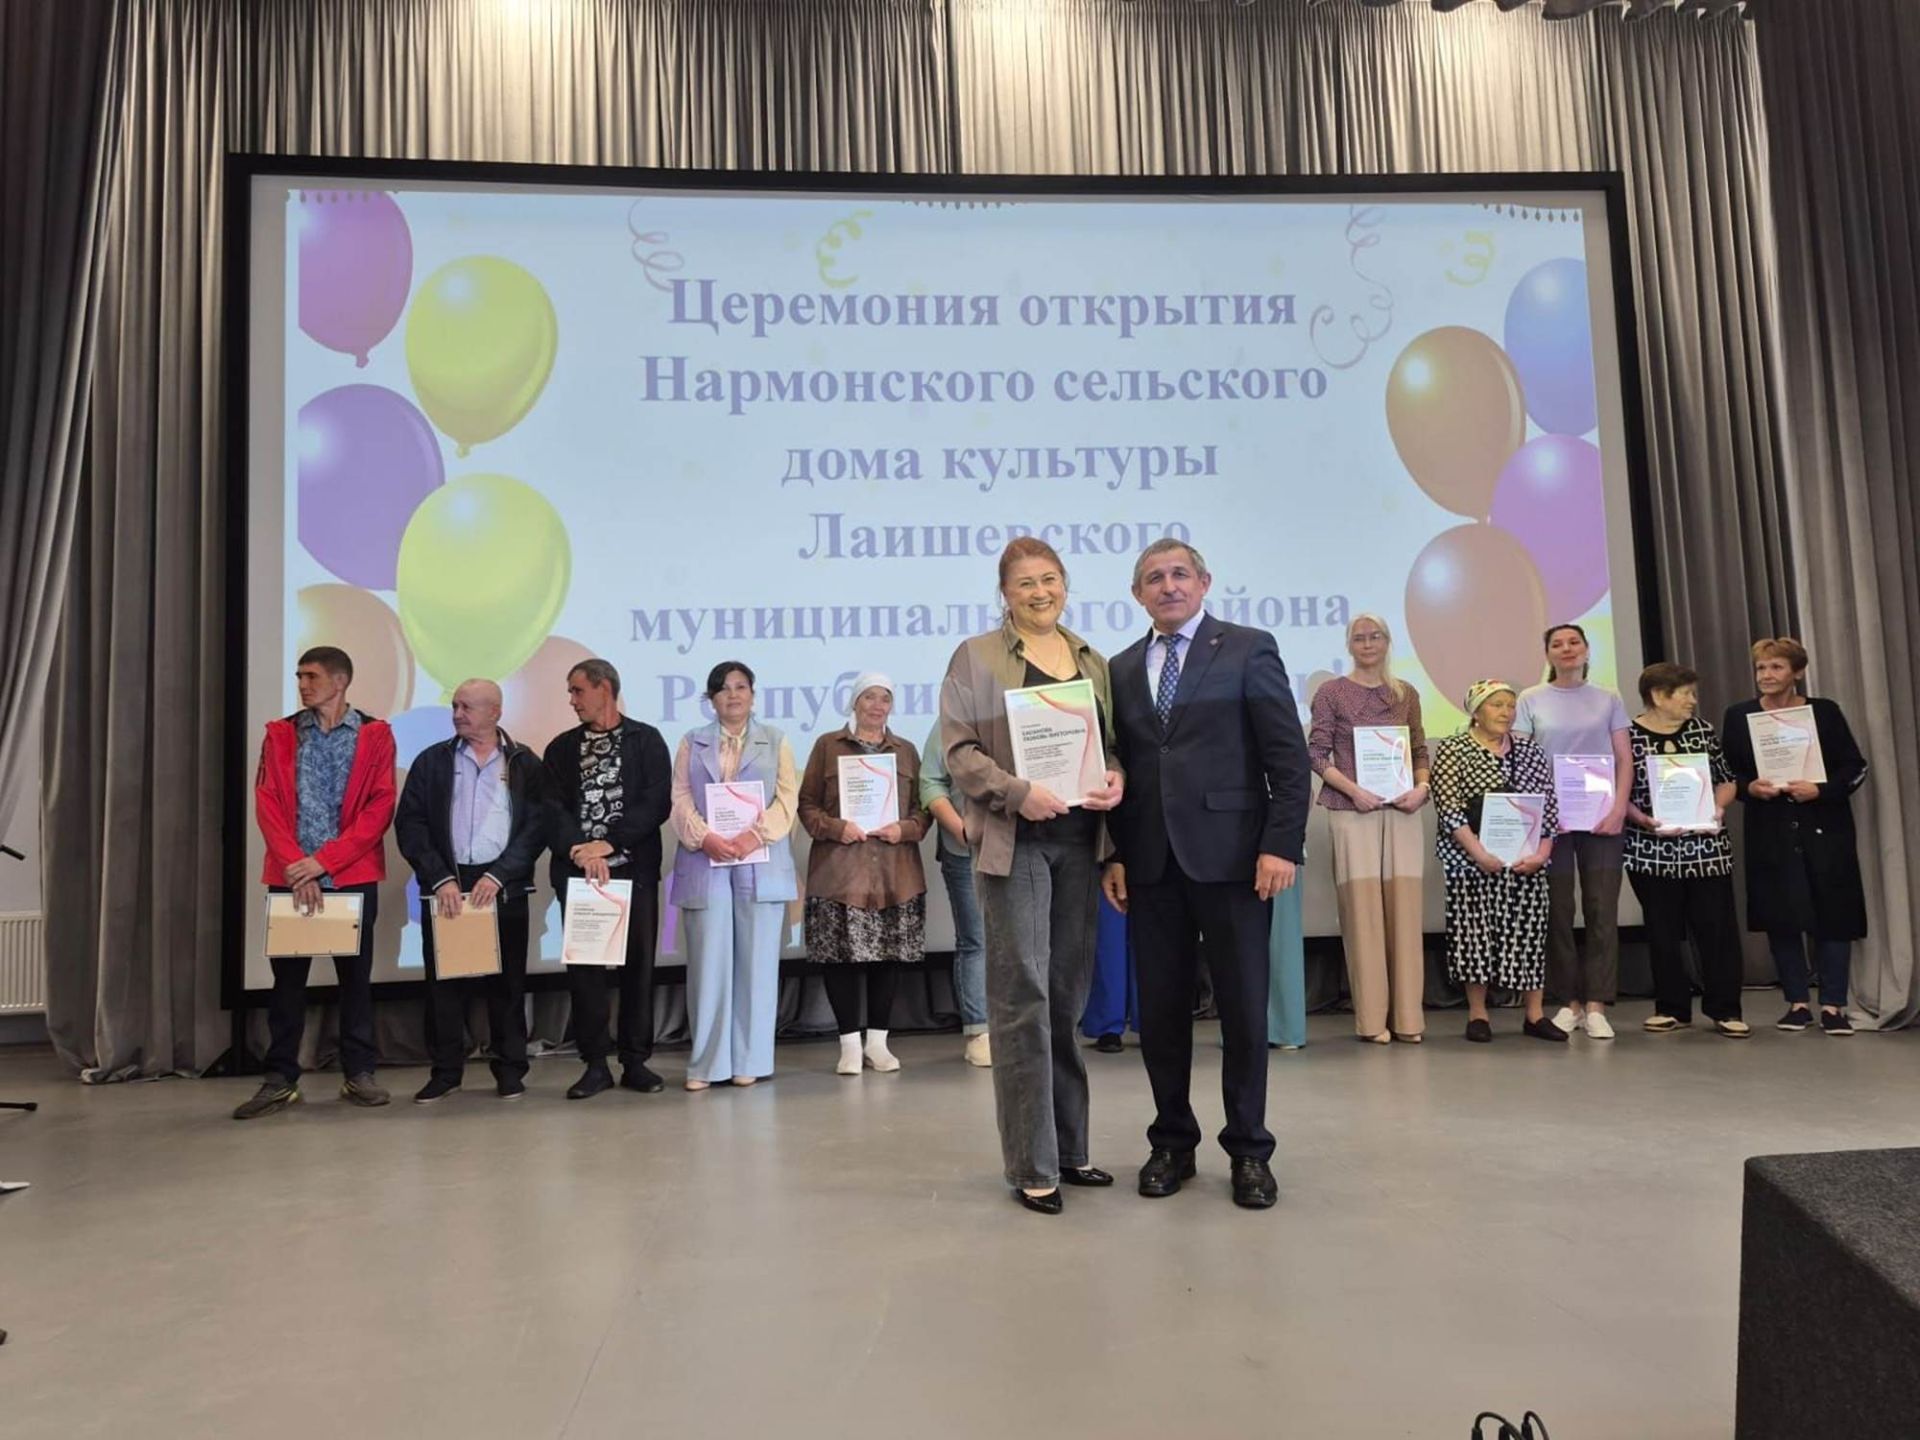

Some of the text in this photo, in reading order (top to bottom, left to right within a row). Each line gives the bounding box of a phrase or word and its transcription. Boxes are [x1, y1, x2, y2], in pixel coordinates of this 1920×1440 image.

[667, 278, 1298, 338] Церемония открытия
[640, 355, 1329, 414] Нармонского сельского
[781, 443, 1220, 492] дома культуры
